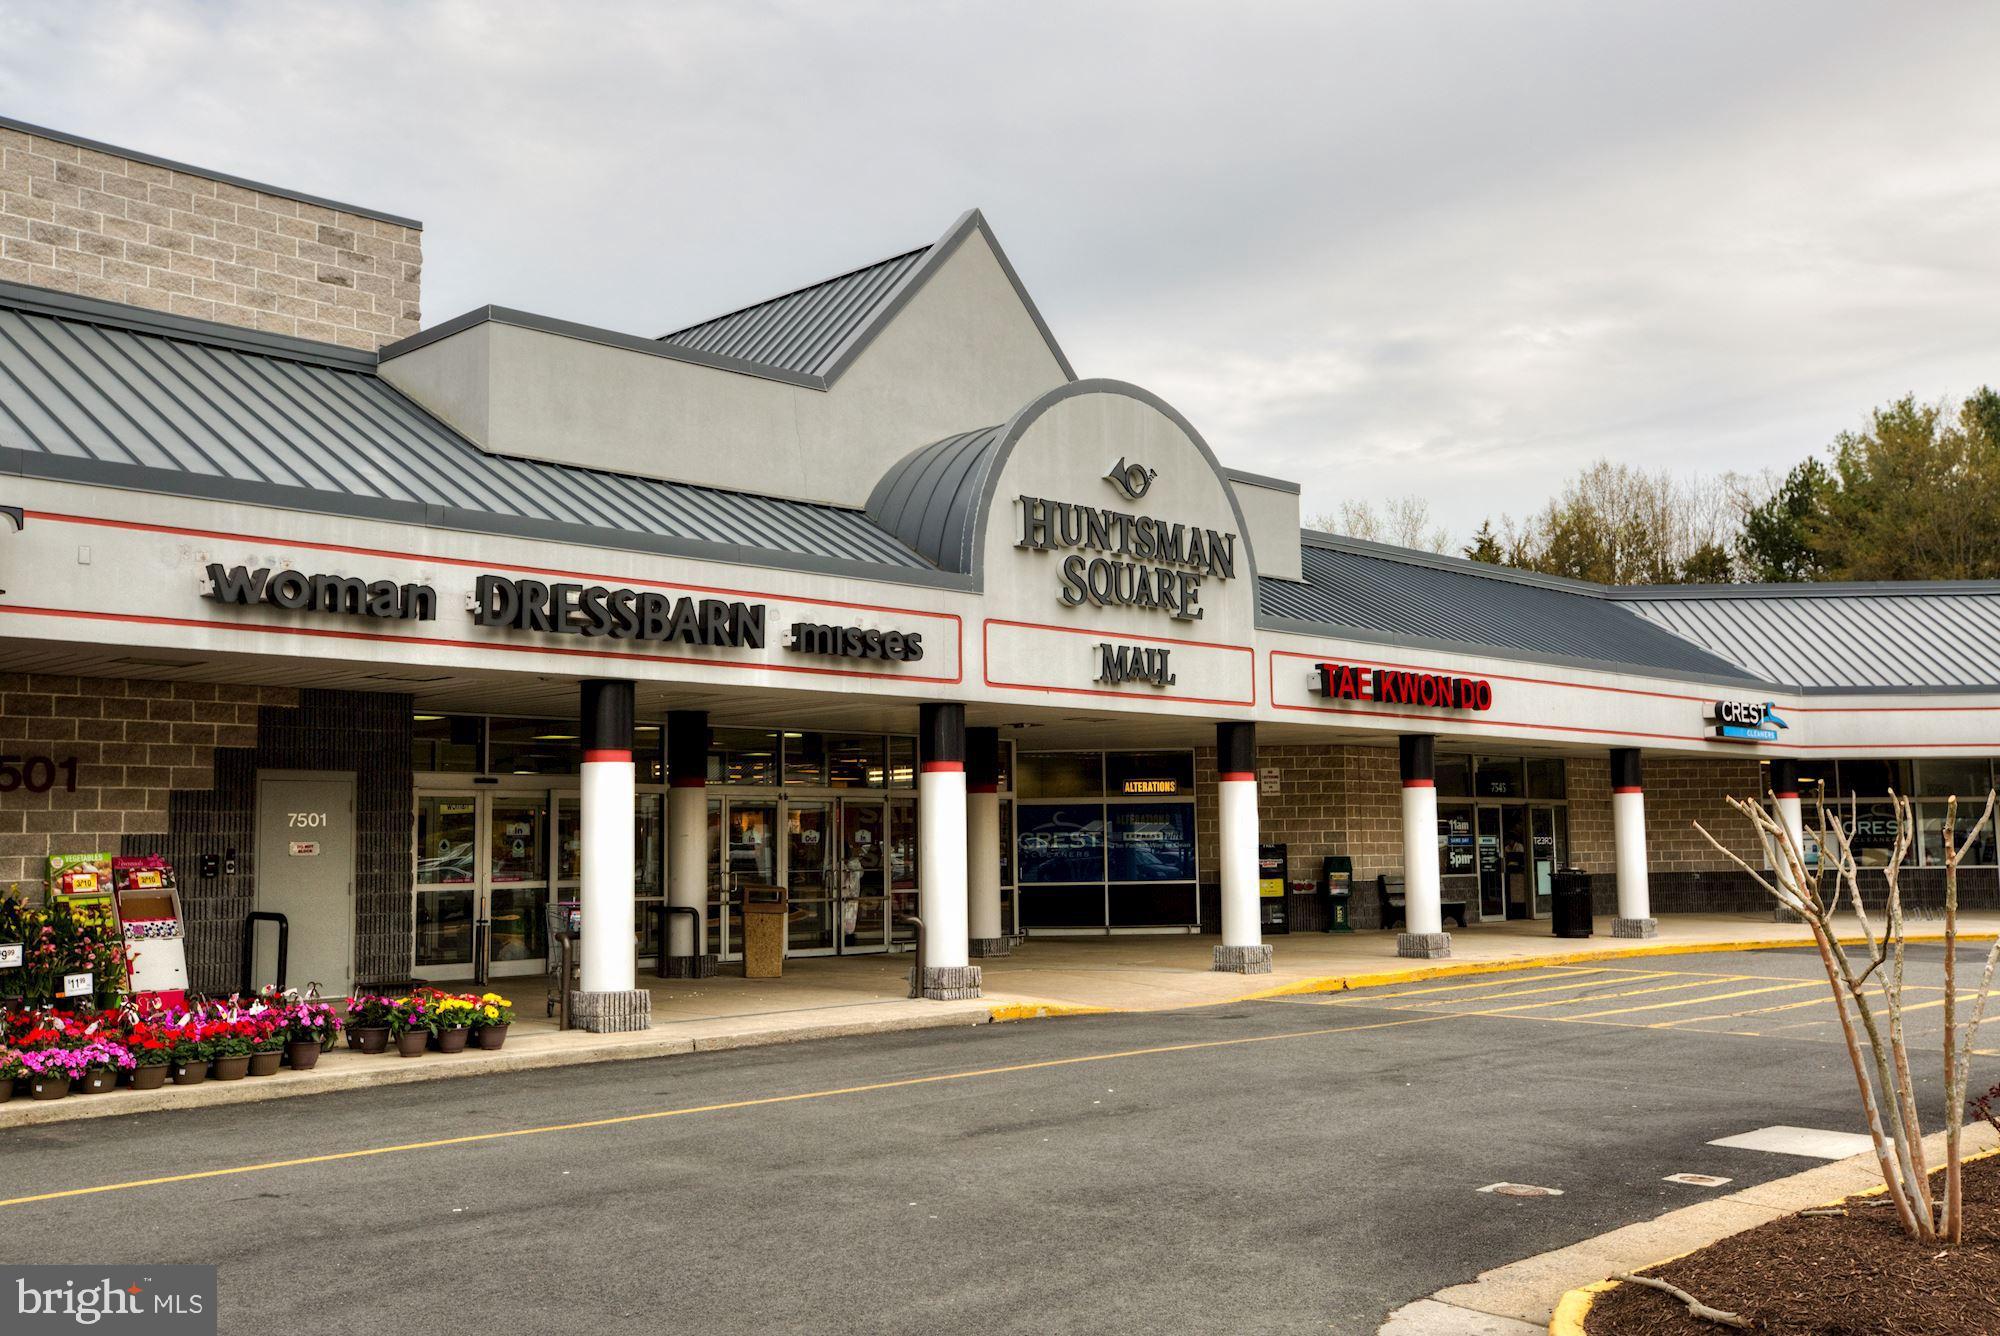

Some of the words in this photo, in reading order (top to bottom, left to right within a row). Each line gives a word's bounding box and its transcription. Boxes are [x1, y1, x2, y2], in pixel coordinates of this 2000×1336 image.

[1014, 494, 1236, 579] HUNTSMAN
[1057, 554, 1204, 620] SQUARE
[475, 574, 766, 649] DRESSBARN
[791, 622, 924, 662] misses
[1094, 643, 1176, 686] MALL
[1318, 663, 1372, 701] TAE
[1374, 669, 1453, 709] KWON
[1454, 678, 1492, 711] DO
[1721, 701, 1767, 724] CREST
[1746, 729, 1776, 740] CLEANERS
[1124, 781, 1176, 793] ALTERATIONS
[287, 812, 327, 828] 7501
[1449, 819, 1469, 831] 11am
[805, 835, 817, 843] Out
[1018, 831, 1101, 849] CREST
[64, 854, 103, 863] VEGETABLES
